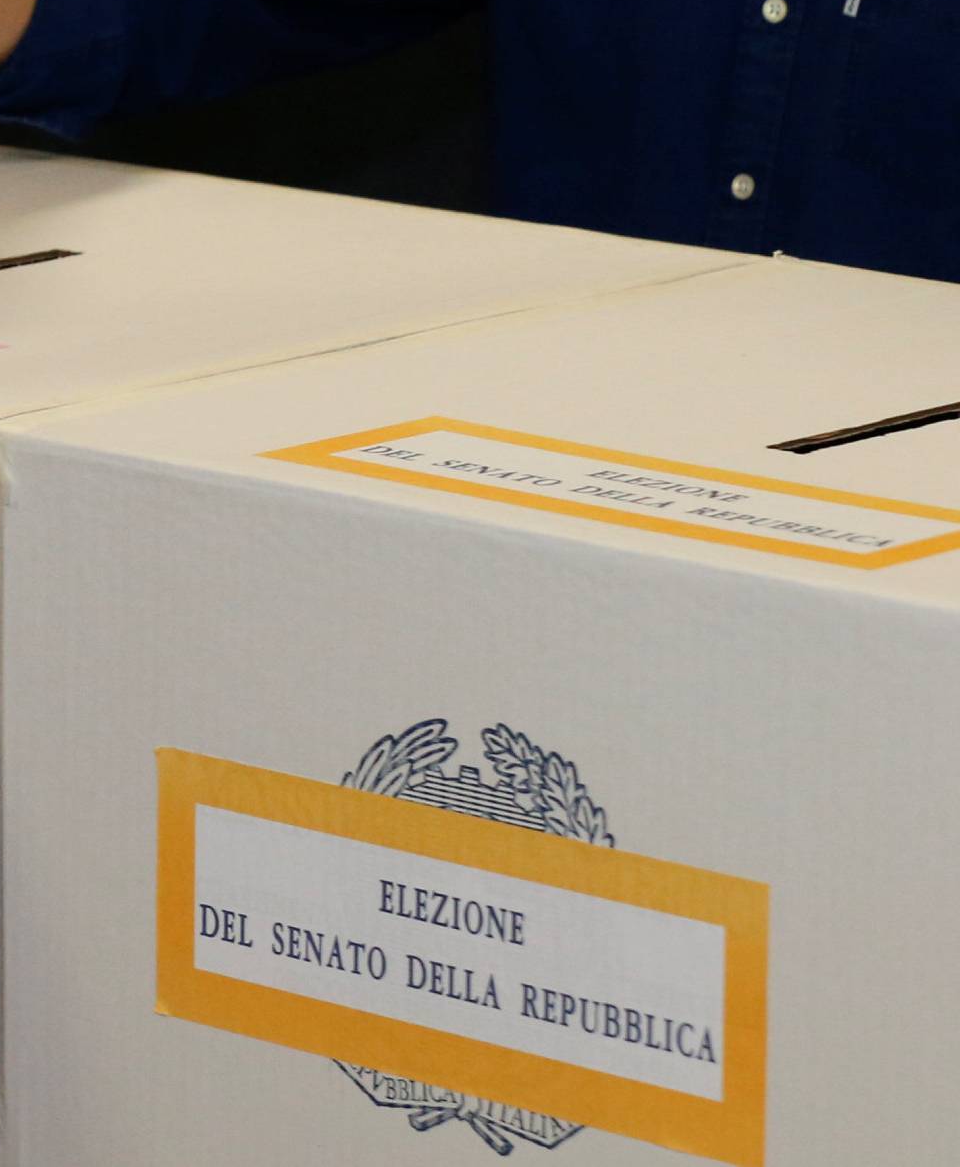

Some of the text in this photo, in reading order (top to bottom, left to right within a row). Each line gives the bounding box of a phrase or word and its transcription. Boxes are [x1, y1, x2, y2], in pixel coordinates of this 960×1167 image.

[360, 444, 896, 549] DEL SENATO DELLA REPUBBLICA
[587, 470, 749, 505] ELEZIONE
[378, 879, 525, 946] ELEZIONE
[199, 902, 718, 1064] DEL SENATO DELLA REPUBBLICA
